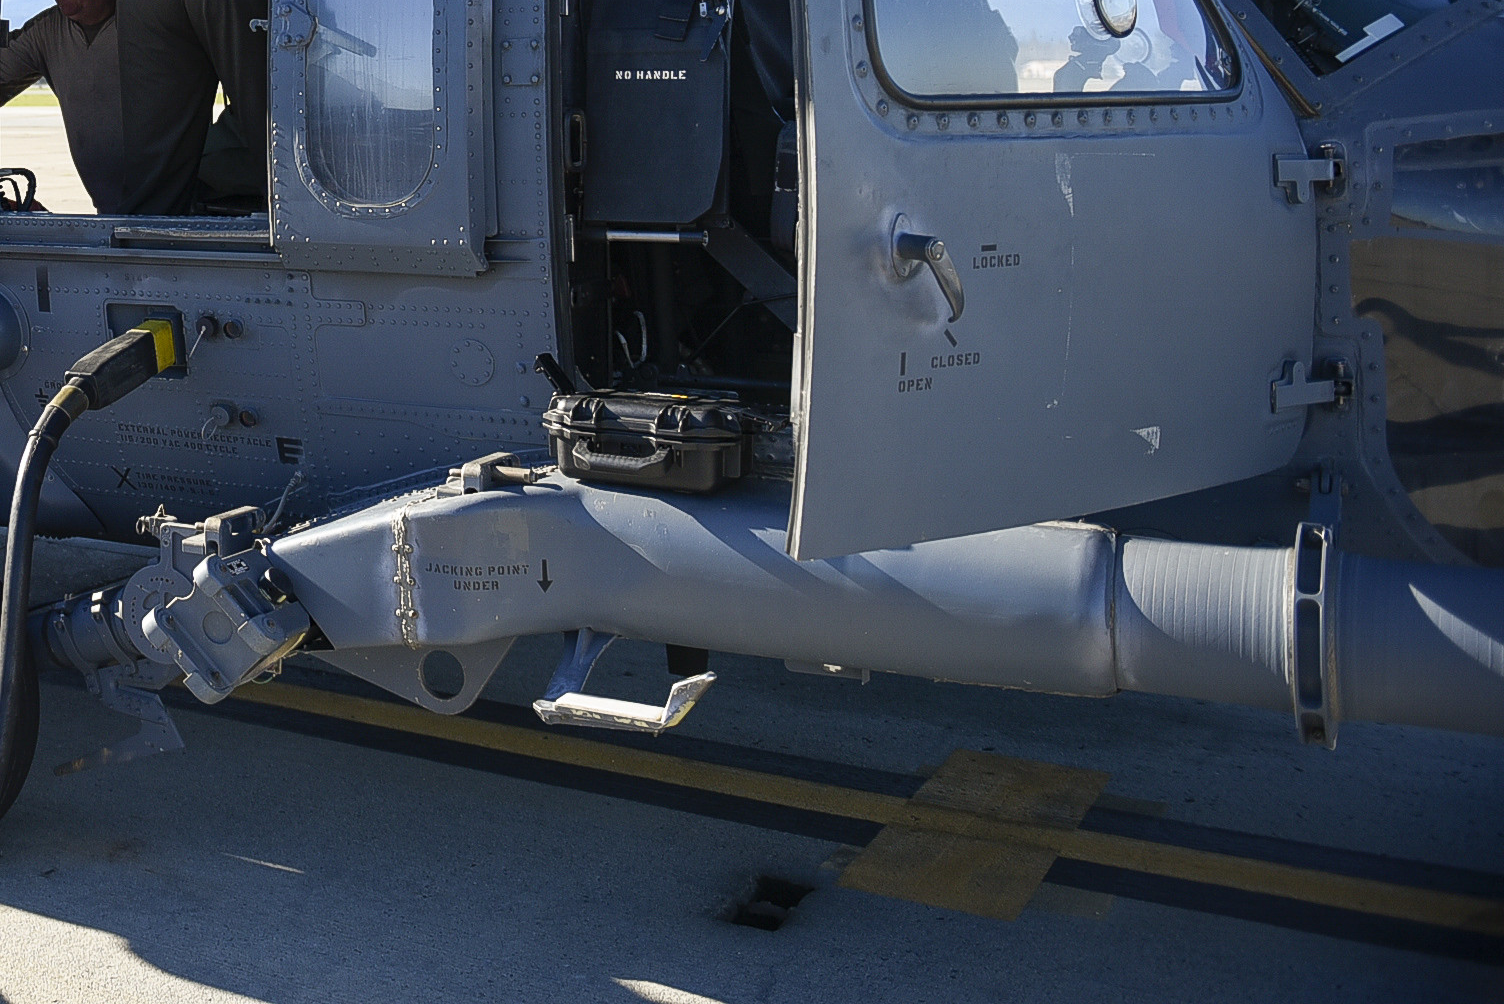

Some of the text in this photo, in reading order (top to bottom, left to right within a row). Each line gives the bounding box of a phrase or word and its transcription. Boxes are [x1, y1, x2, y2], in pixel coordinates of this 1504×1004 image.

[615, 70, 687, 80] NO HANDLE
[972, 253, 1021, 269] LOCKED
[930, 352, 981, 369] CLOSED
[898, 377, 933, 393] OPEN
[118, 423, 272, 448] EXTERNAL POWER RECEPTACLE
[120, 434, 238, 454] 115/200 VAC 400 CYCLE
[136, 472, 212, 486] TIRE PRESSURE
[425, 563, 530, 576] JACKING POINT
[453, 580, 500, 591] UNDER
